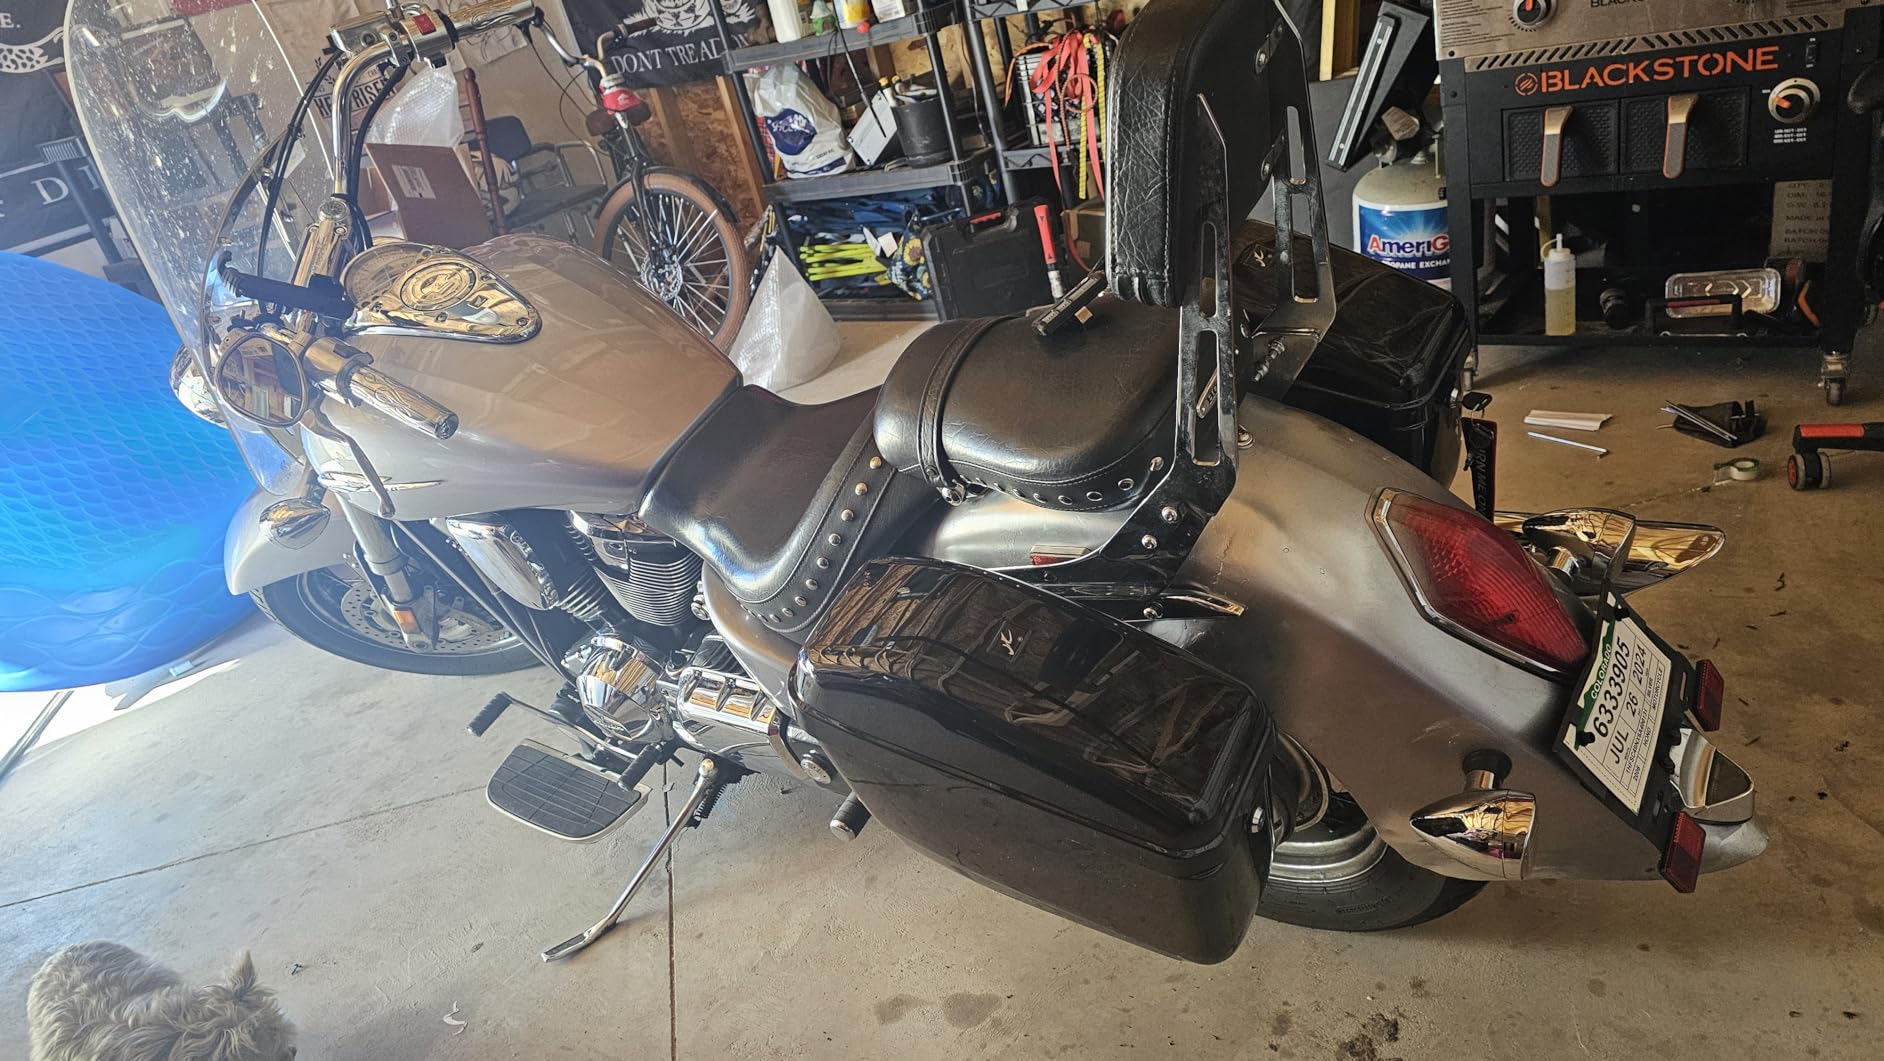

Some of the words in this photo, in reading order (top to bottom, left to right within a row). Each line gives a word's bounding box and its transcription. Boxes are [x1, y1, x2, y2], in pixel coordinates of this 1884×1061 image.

[611, 48, 663, 75] DONT
[1541, 45, 1780, 93] BLACKSTONE
[1368, 234, 1450, 255] AmeriG
[1419, 259, 1450, 269] EXCHA
[1591, 643, 1611, 700] COLORADO
[1593, 636, 1630, 738] 6333905
[1652, 668, 1663, 710] MOTORCYCLE
[1610, 730, 1629, 764] JUL
[1626, 692, 1638, 717] 26
[1633, 644, 1646, 685] 2024
